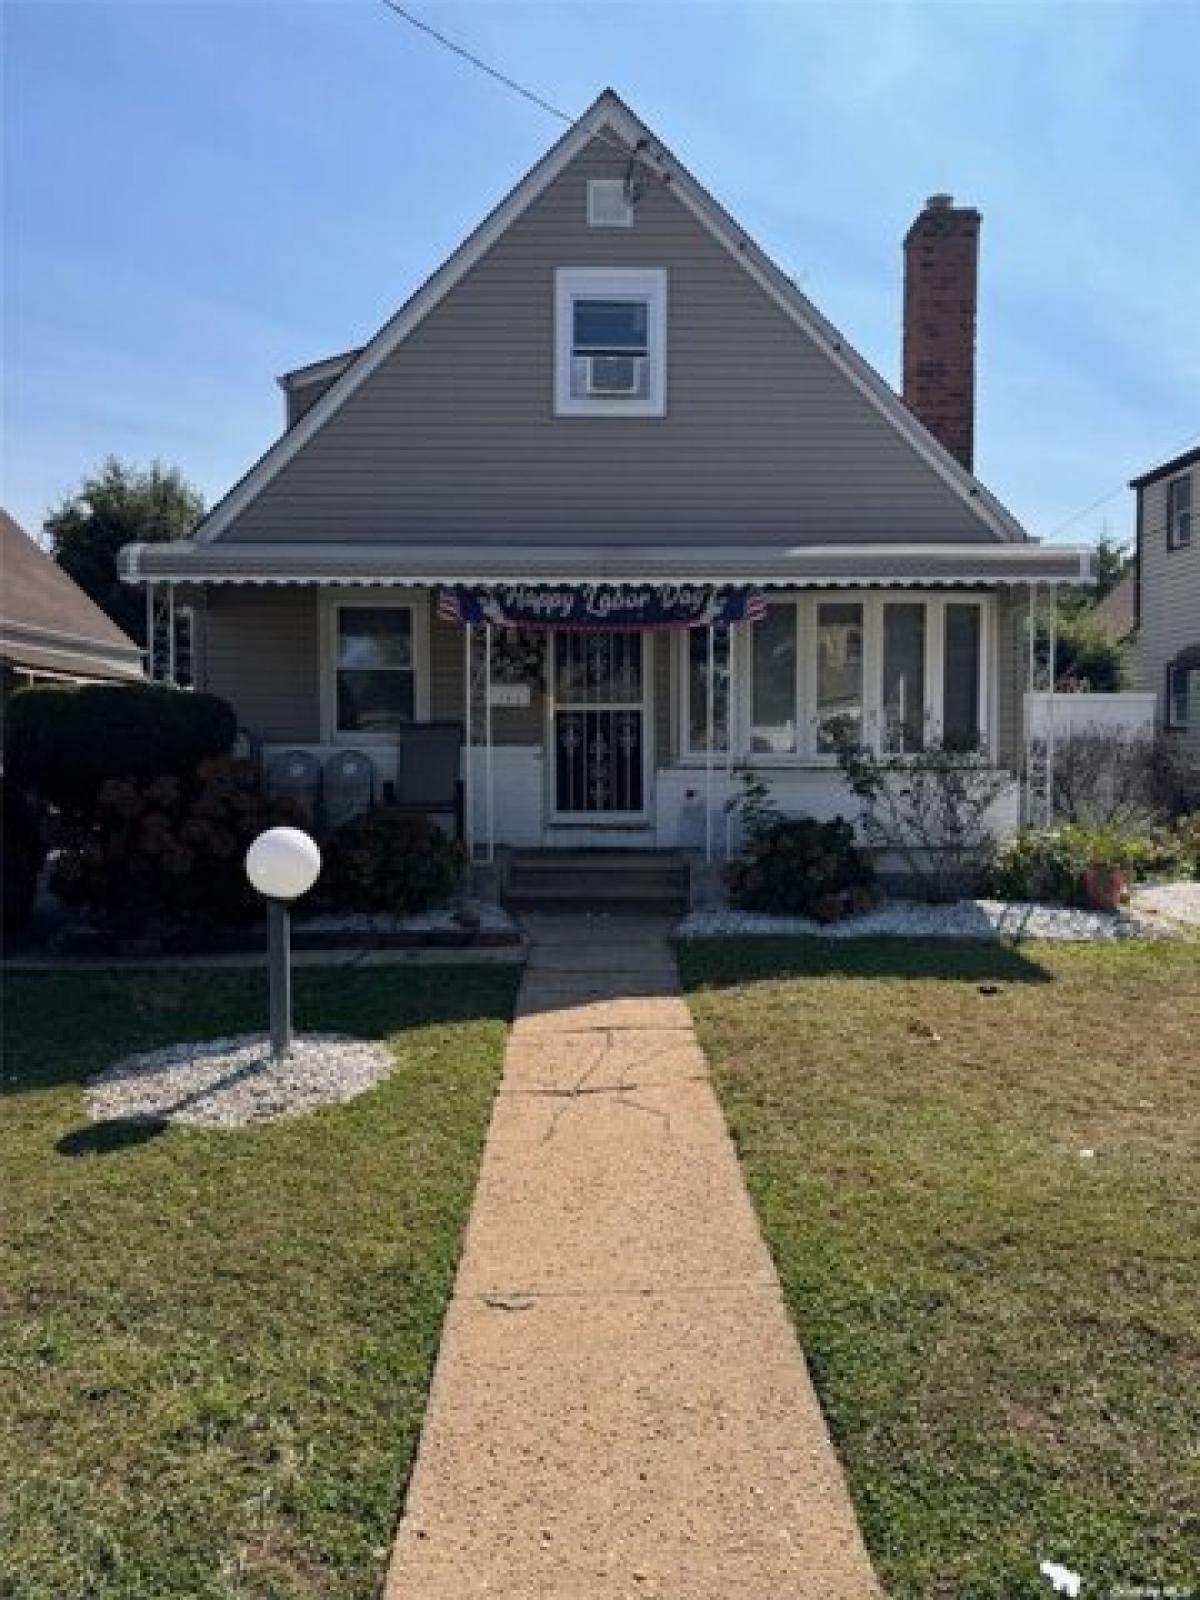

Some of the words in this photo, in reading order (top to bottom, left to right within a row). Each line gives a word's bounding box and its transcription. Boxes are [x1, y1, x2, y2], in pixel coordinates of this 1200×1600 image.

[505, 586, 574, 617] Happy
[583, 584, 650, 617] Labor
[656, 584, 705, 614] Day
